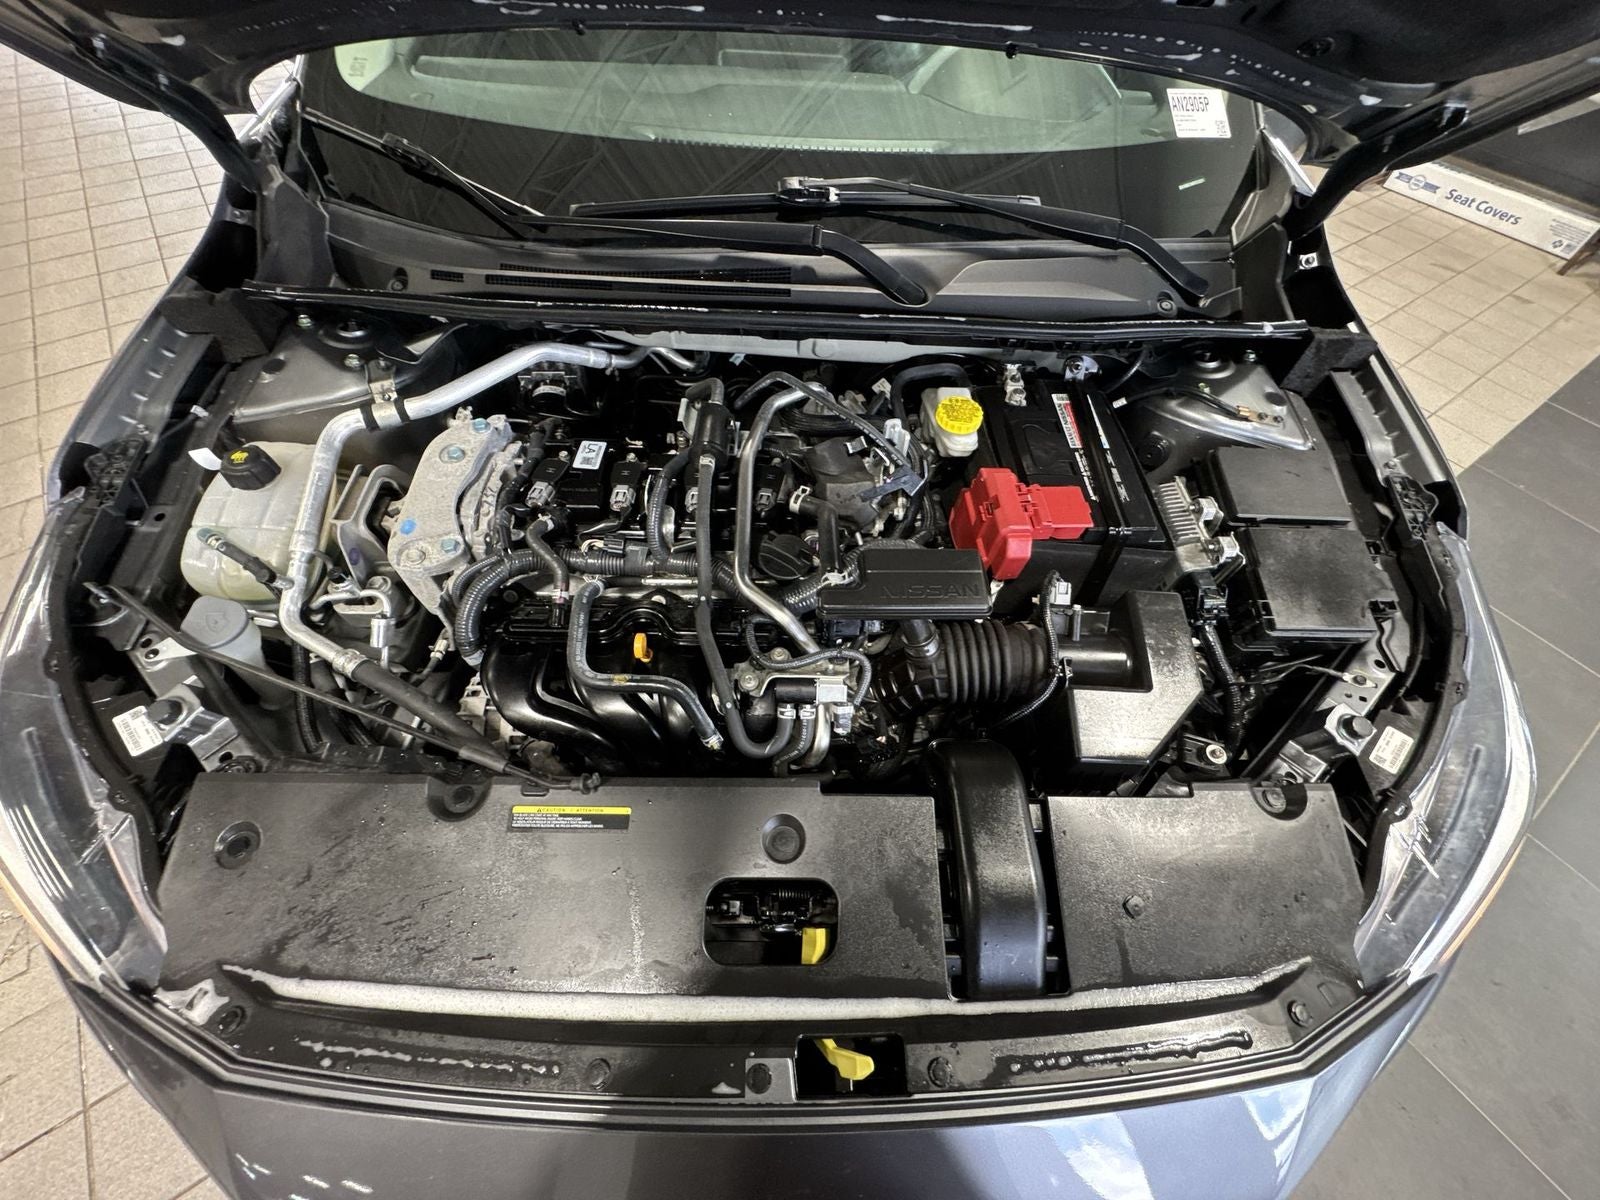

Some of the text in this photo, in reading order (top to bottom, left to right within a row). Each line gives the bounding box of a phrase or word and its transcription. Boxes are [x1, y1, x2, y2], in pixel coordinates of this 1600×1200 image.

[1172, 96, 1209, 112] AN2905P
[1444, 188, 1523, 225] Seat Covers
[881, 584, 983, 599] NISSAN
